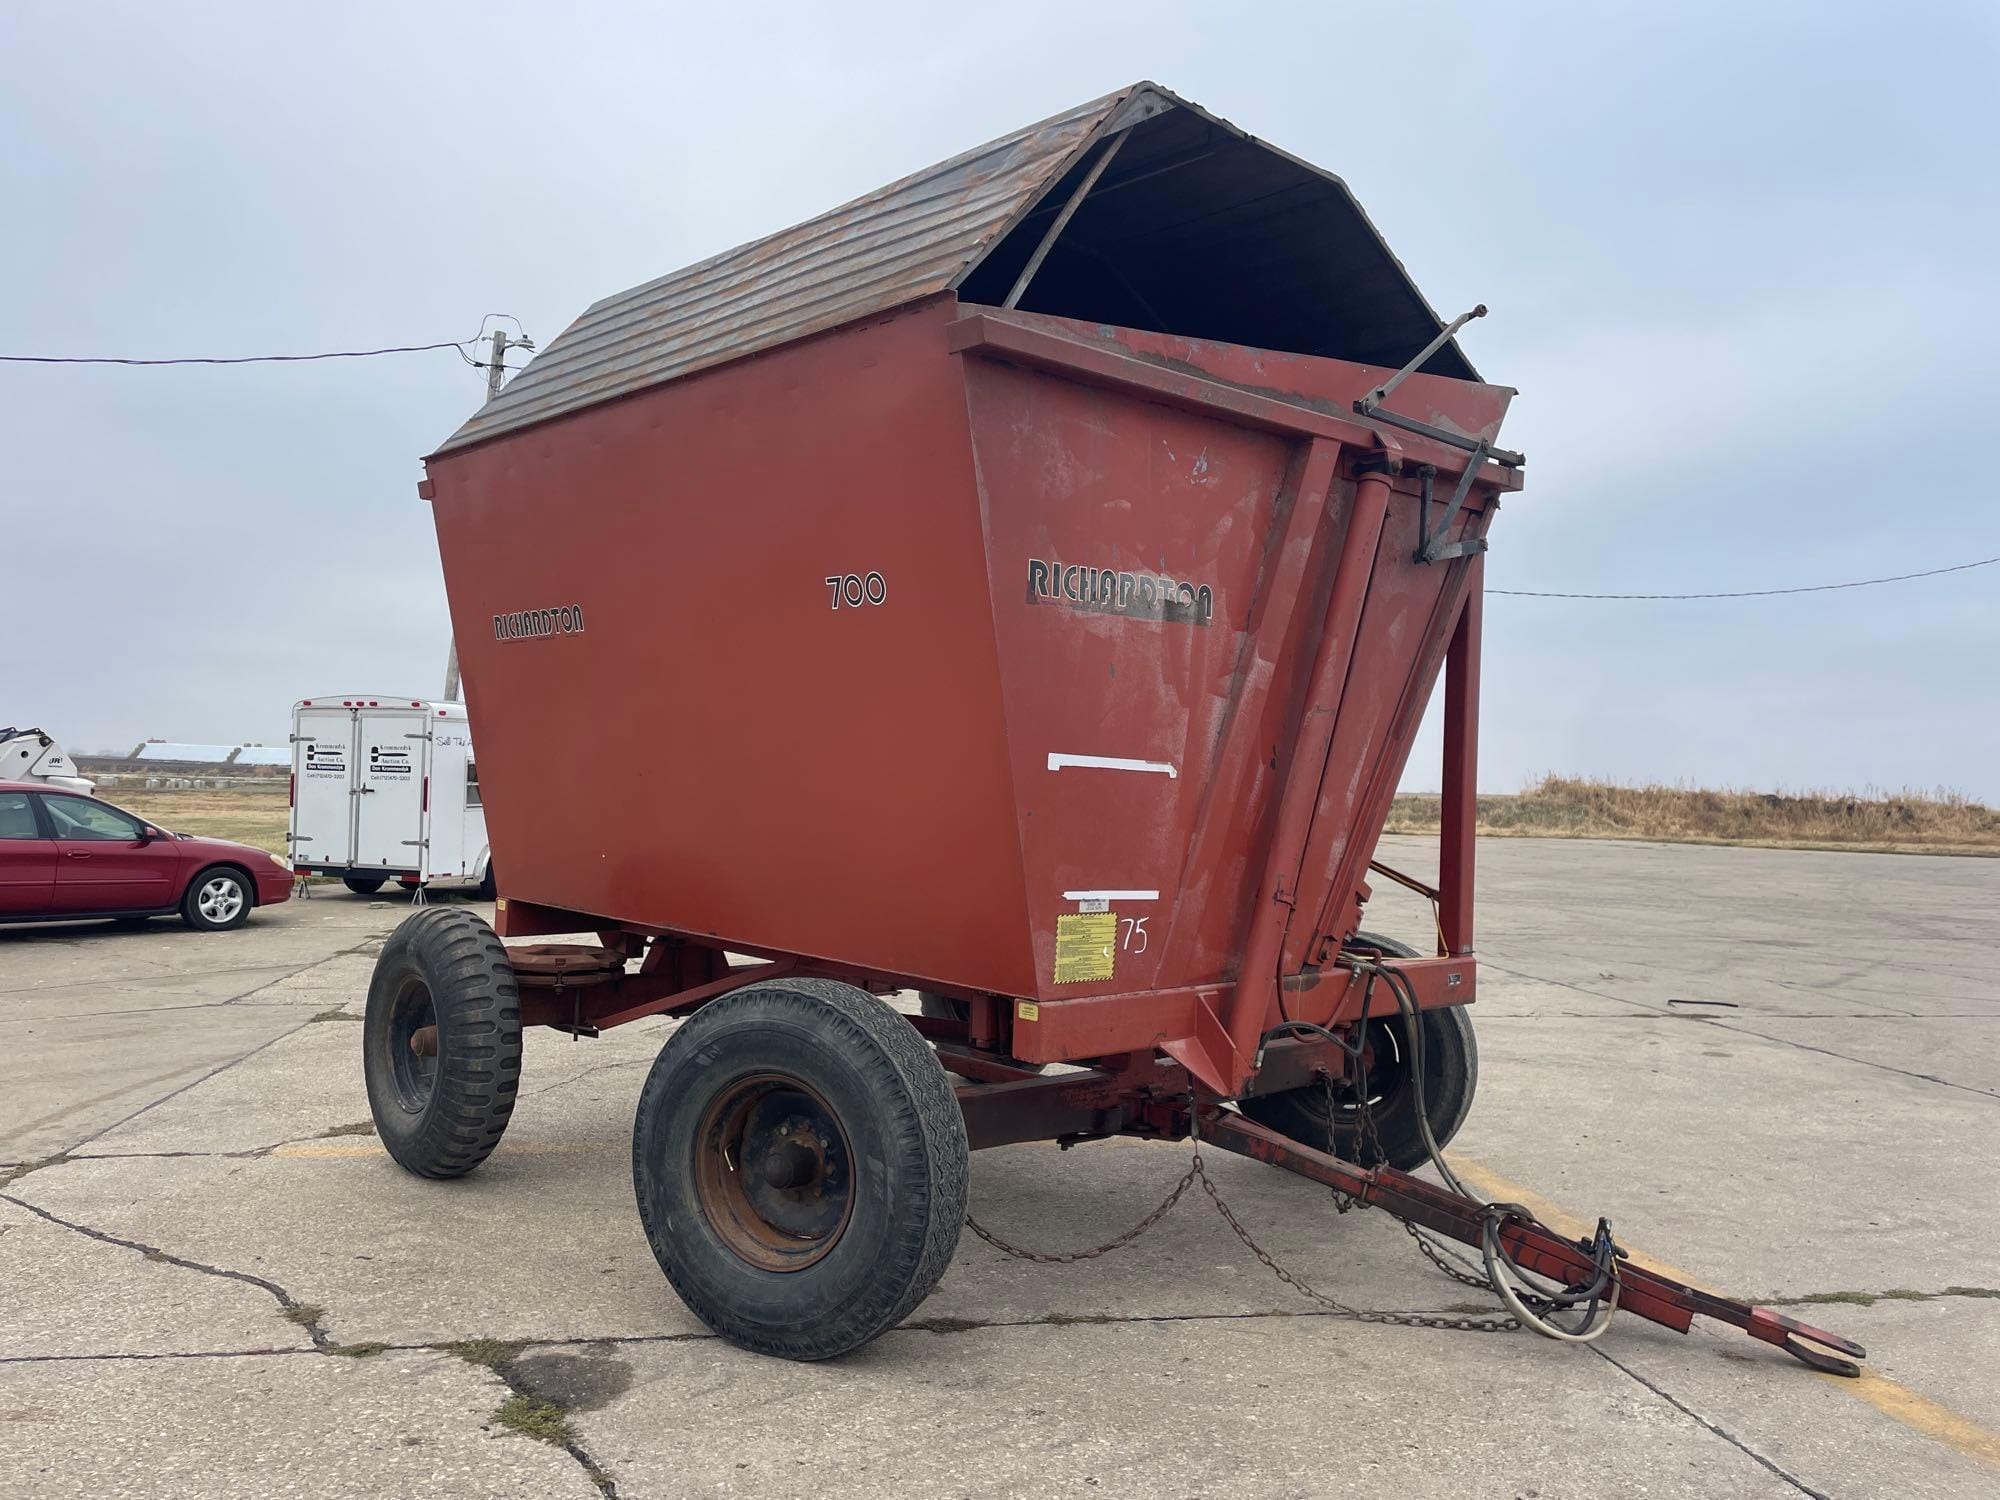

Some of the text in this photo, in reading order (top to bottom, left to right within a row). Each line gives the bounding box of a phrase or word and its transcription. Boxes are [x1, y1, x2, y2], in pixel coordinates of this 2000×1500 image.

[825, 571, 887, 610] 700
[1028, 558, 1213, 620] RICHARDTON
[493, 604, 585, 641] RICHARDTON
[1121, 916, 1150, 954] 75
